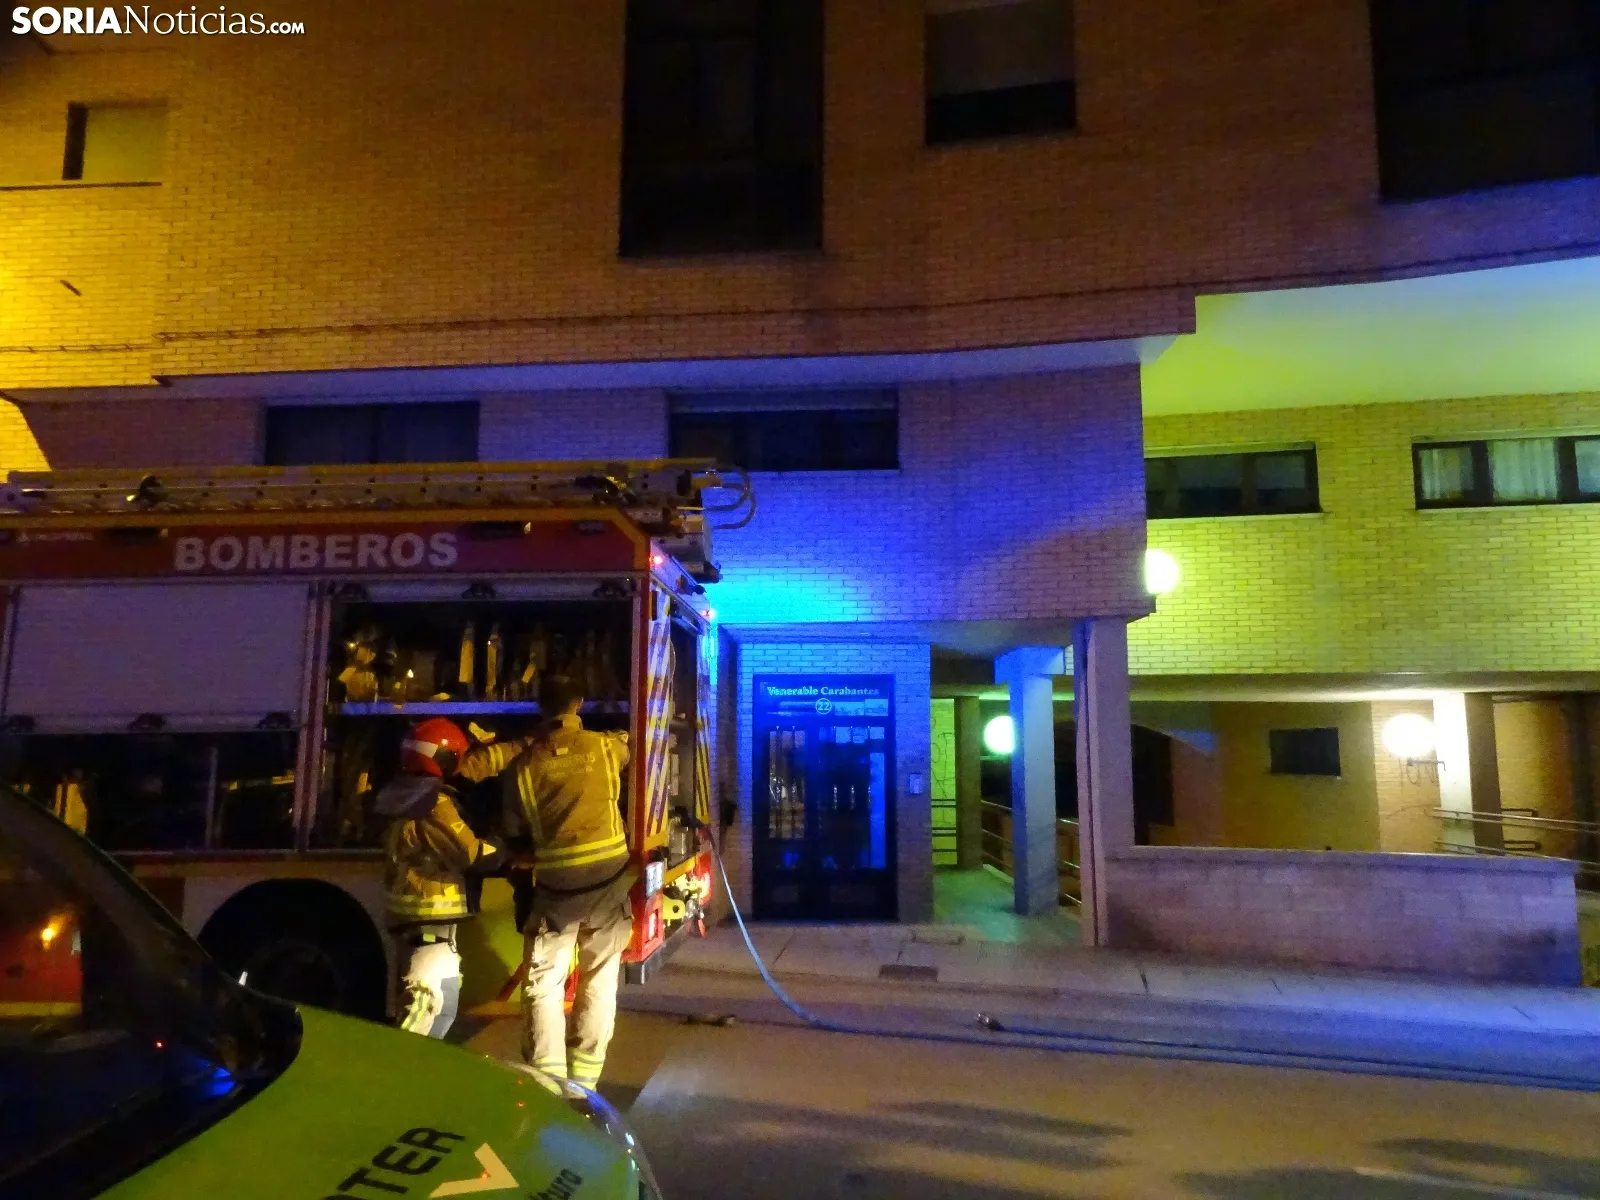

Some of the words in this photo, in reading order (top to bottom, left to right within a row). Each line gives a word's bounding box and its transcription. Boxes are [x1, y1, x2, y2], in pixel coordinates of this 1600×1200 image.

[174, 532, 458, 571] BOMBEROS
[767, 686, 819, 696] Venerable
[322, 1127, 466, 1200] TER
